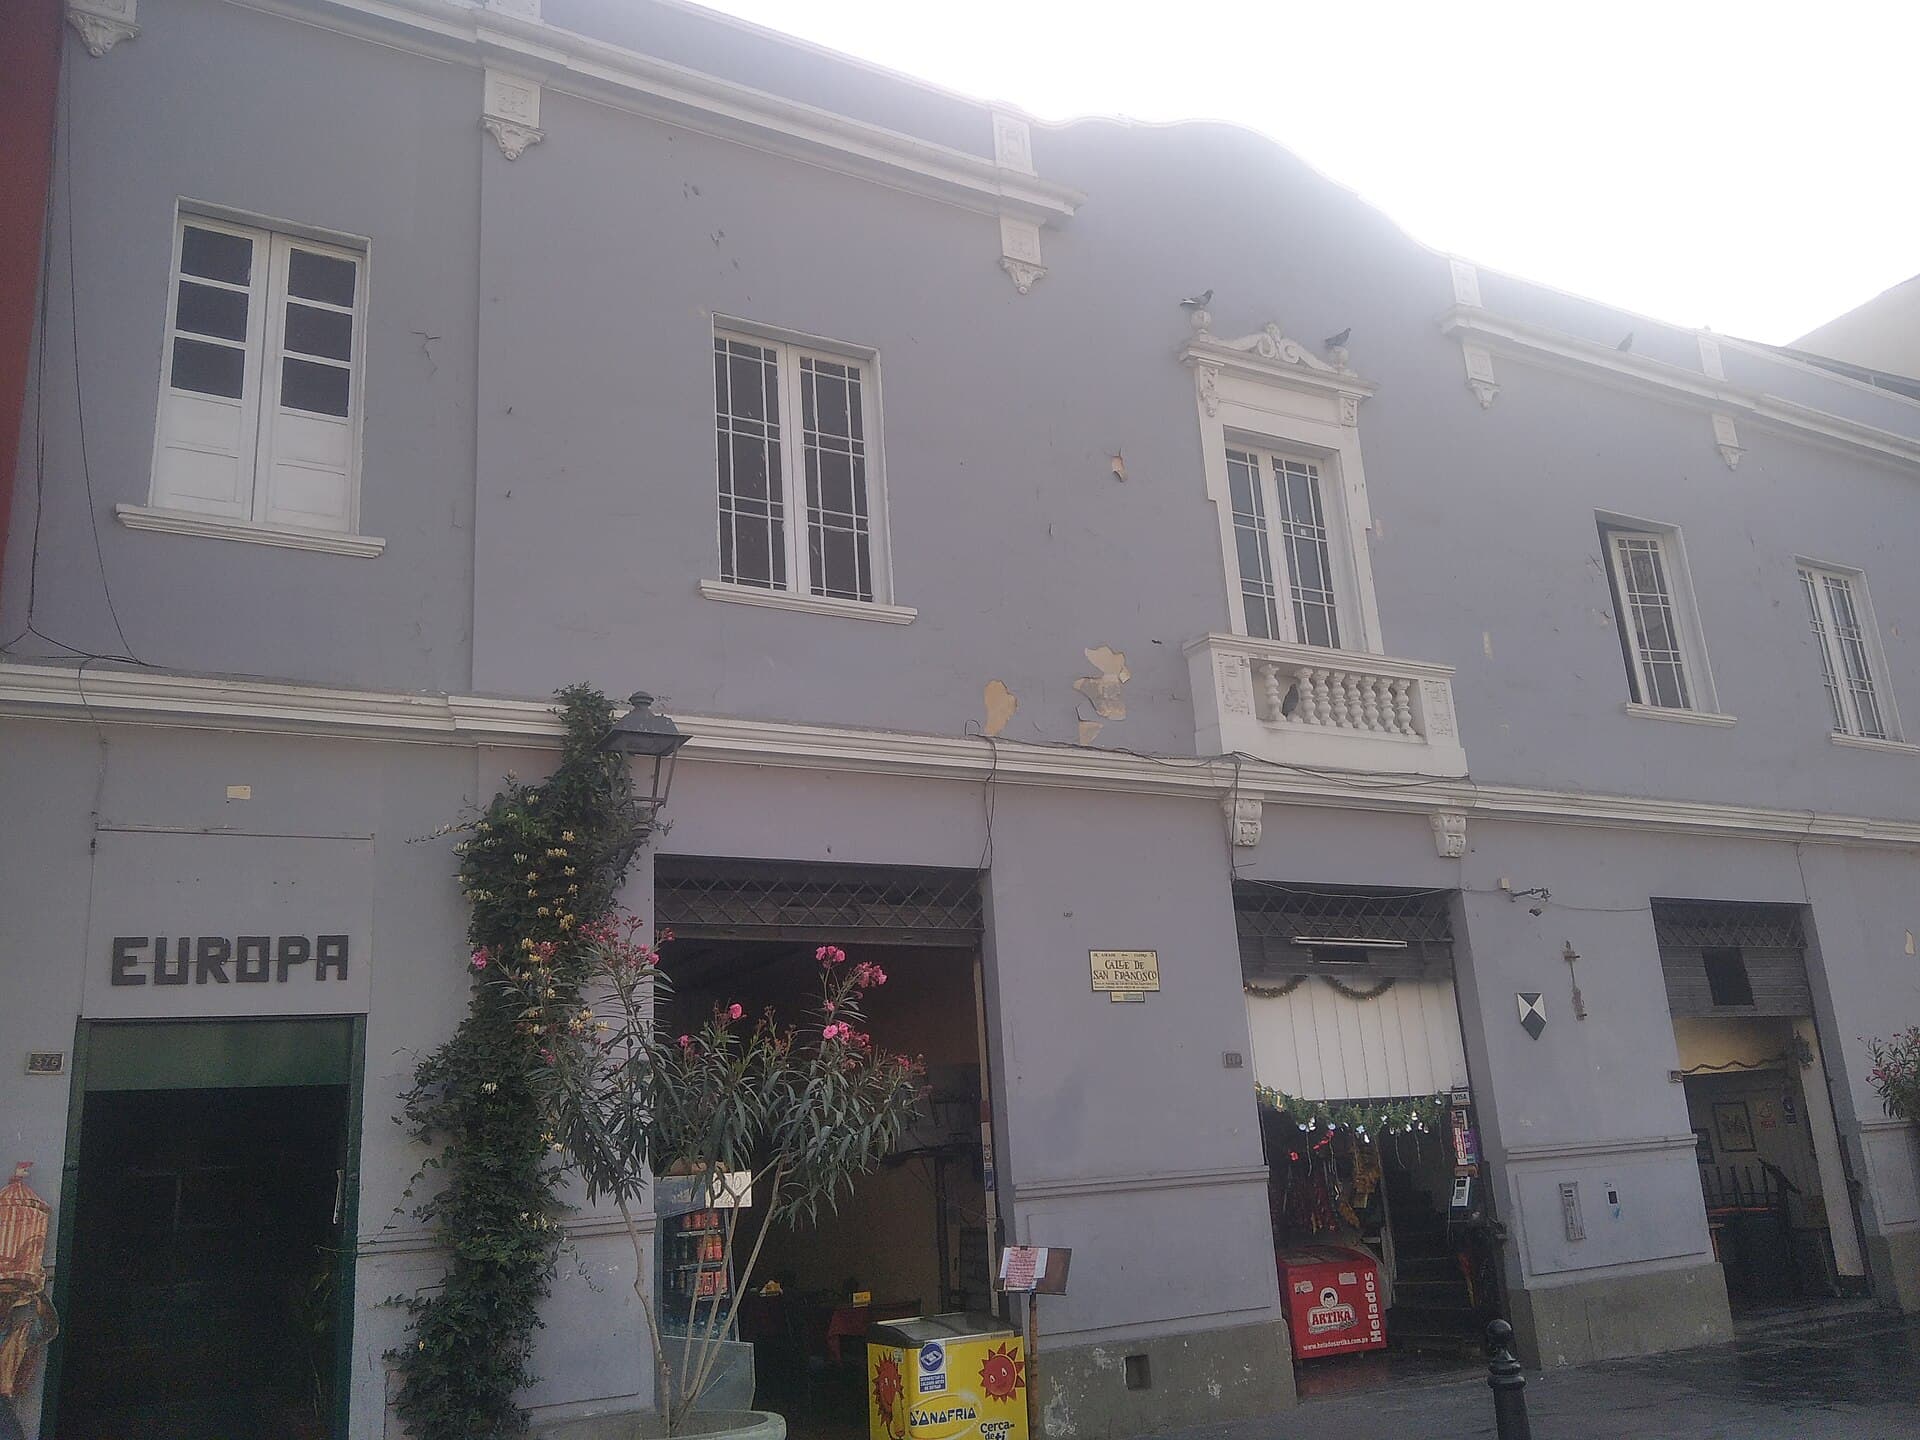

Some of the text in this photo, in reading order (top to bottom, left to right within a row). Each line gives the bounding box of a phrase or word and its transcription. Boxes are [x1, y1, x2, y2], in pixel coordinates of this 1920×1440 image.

[111, 935, 349, 985] EUROPA
[1105, 960, 1145, 970] CALLE DE
[1093, 970, 1157, 982] SAN FRANCISCO
[1364, 1272, 1382, 1343] Helados
[1312, 1310, 1351, 1325] ARTIKA
